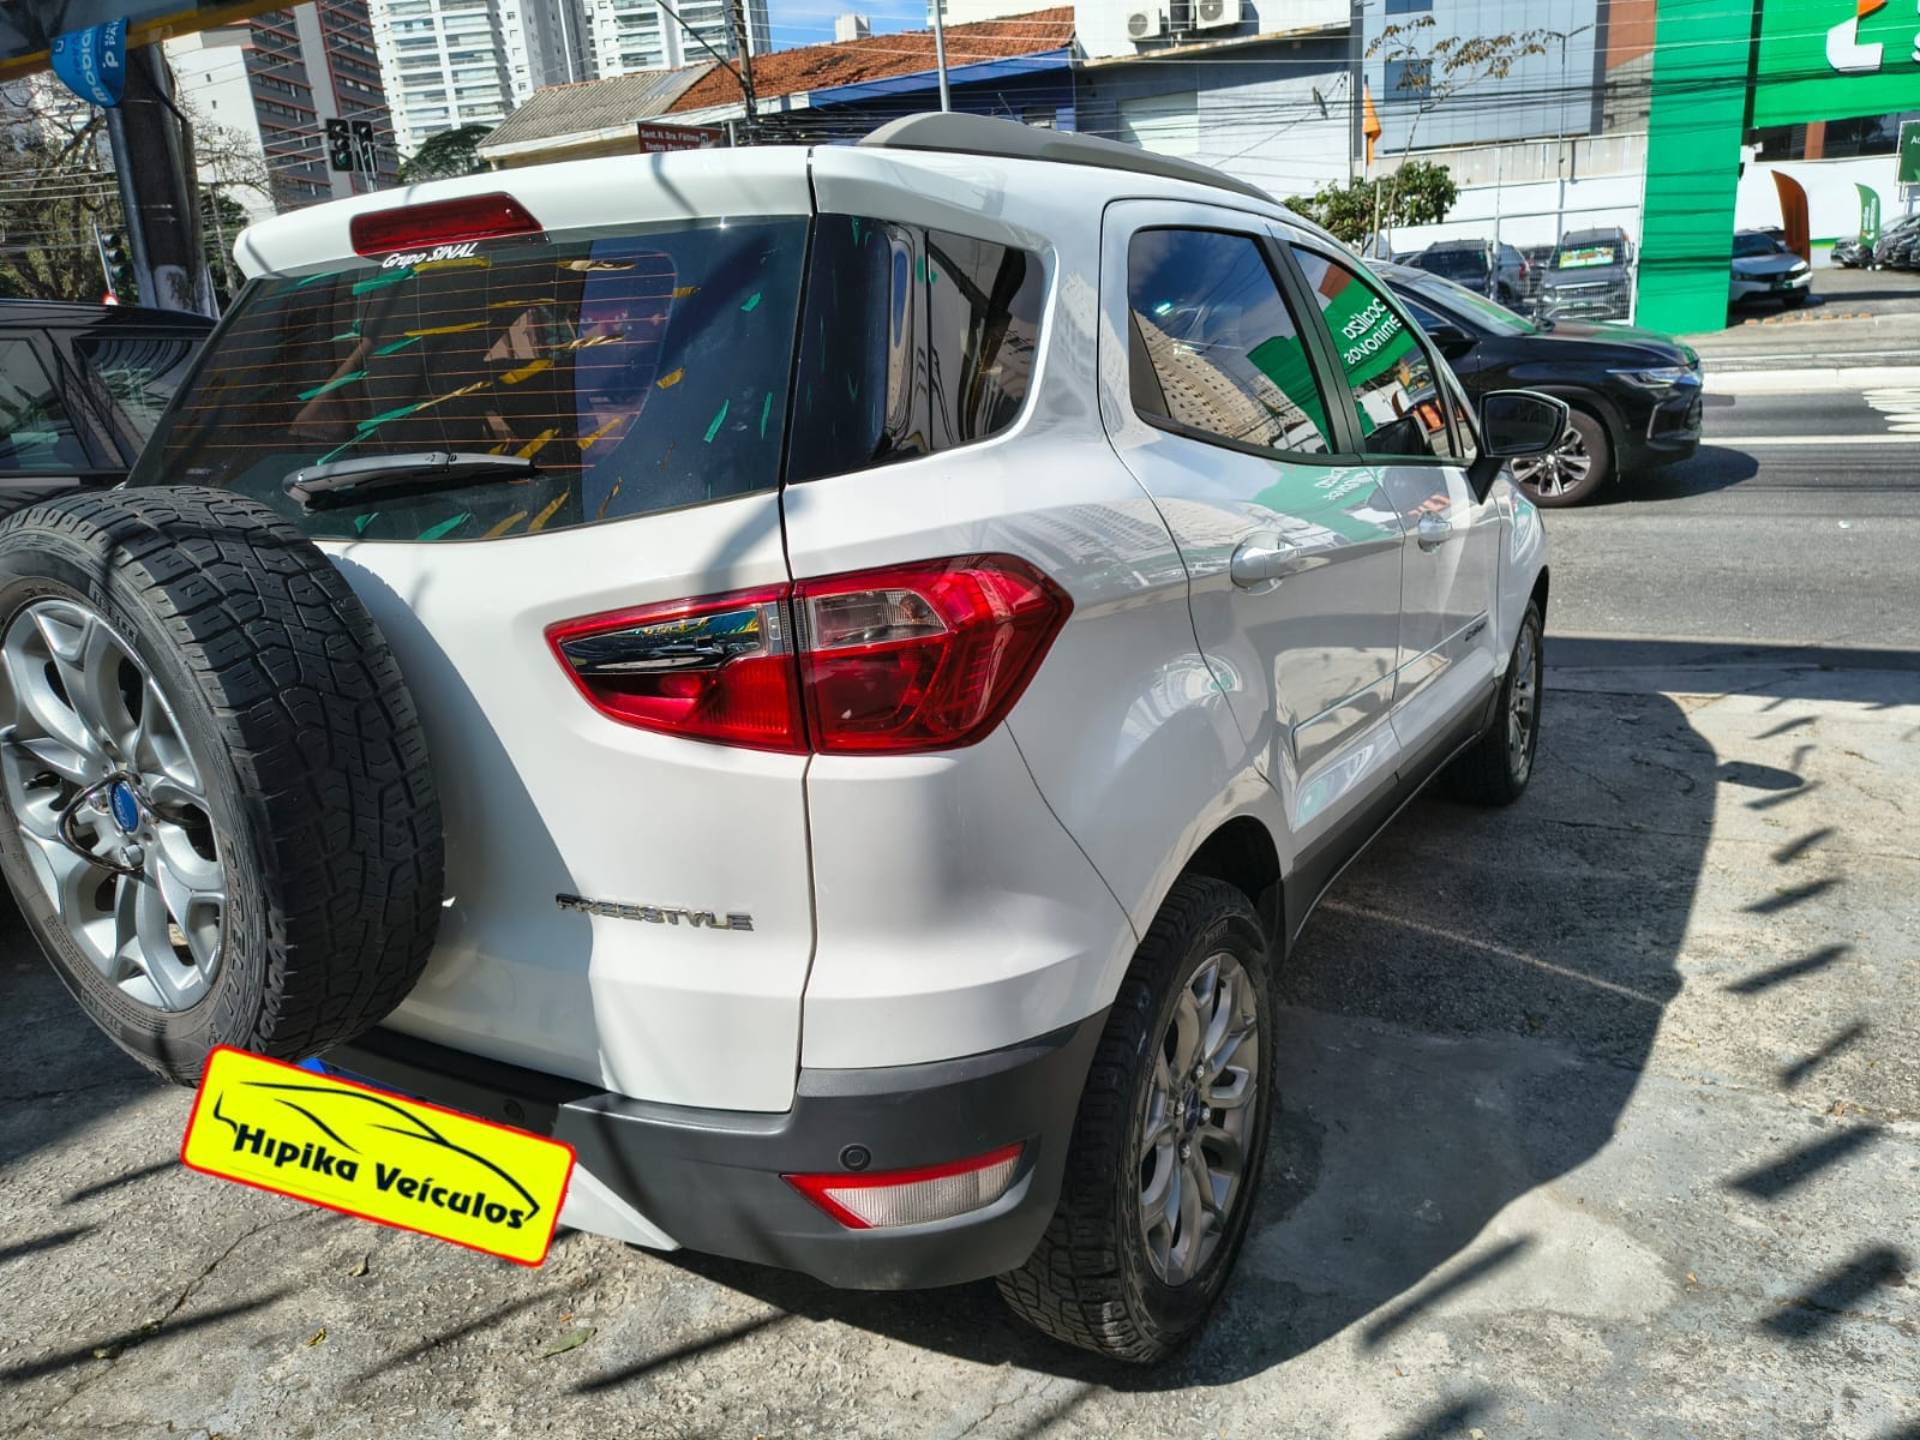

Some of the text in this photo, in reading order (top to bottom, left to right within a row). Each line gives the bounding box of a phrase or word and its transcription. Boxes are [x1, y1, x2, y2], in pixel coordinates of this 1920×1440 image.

[81, 28, 108, 102] mobia
[382, 242, 479, 269] Grupo SINAL
[556, 892, 754, 931] FREESTYLE
